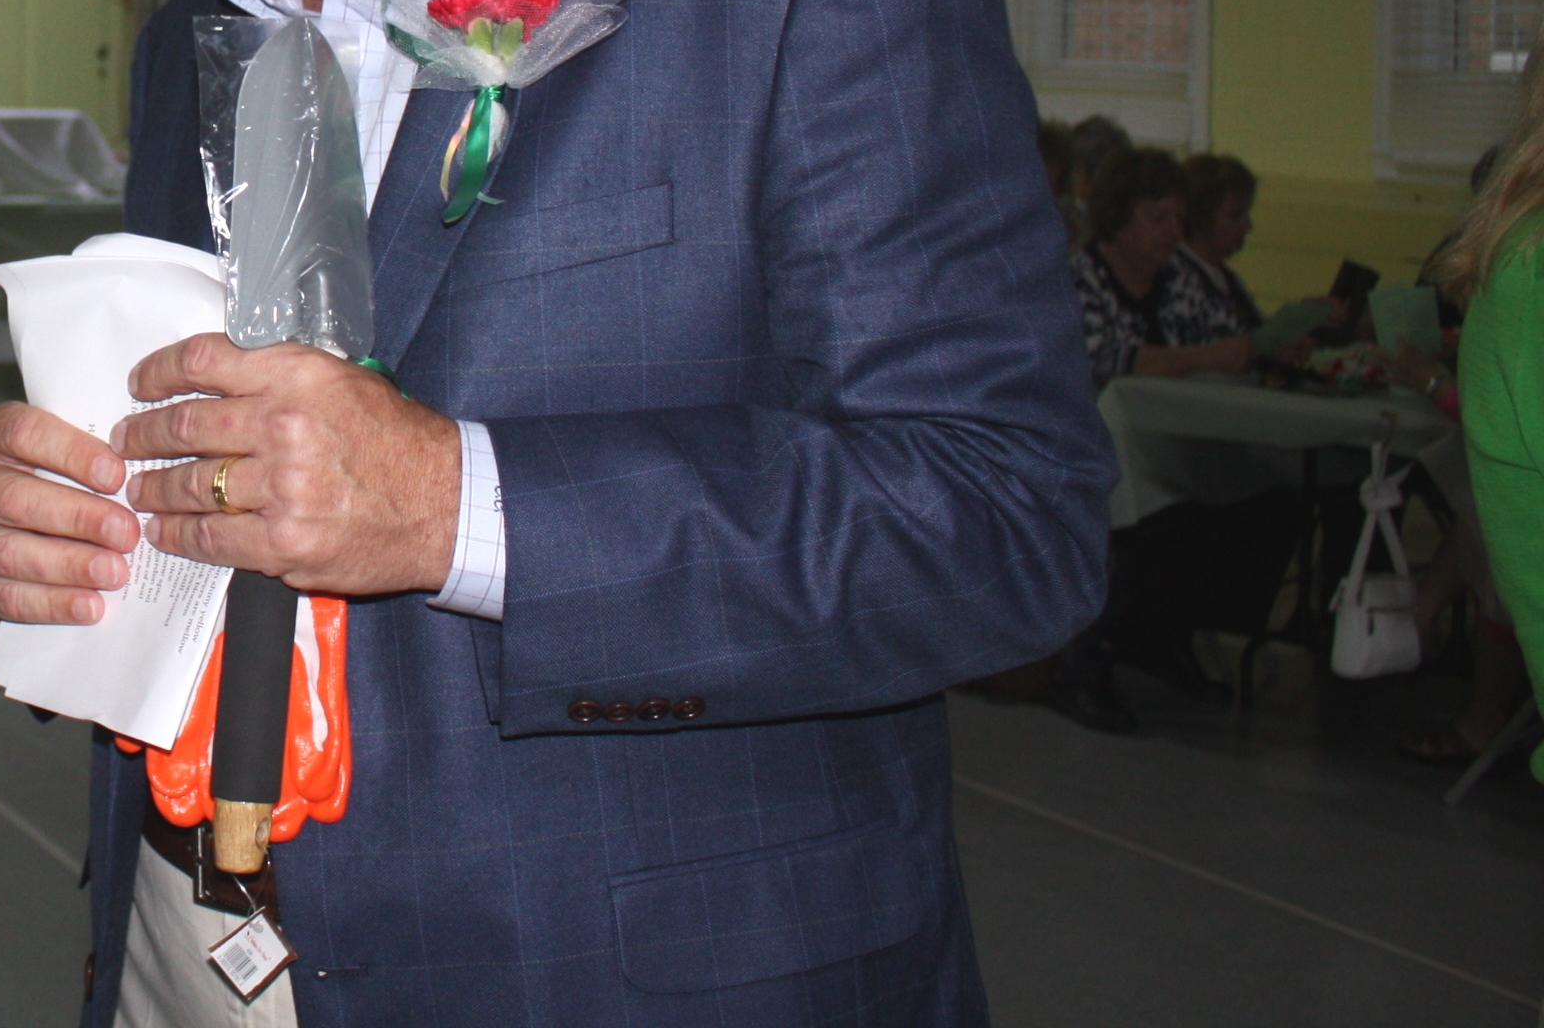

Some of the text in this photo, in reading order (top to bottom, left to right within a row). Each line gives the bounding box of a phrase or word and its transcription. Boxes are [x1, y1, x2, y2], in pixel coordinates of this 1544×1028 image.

[168, 562, 176, 582] nice
[169, 561, 184, 598] abound
[164, 592, 180, 627] around
[177, 567, 215, 654] lowers are mellow
[182, 582, 200, 616] blooms
[203, 581, 217, 607] shiny
[192, 609, 207, 643] yellow
